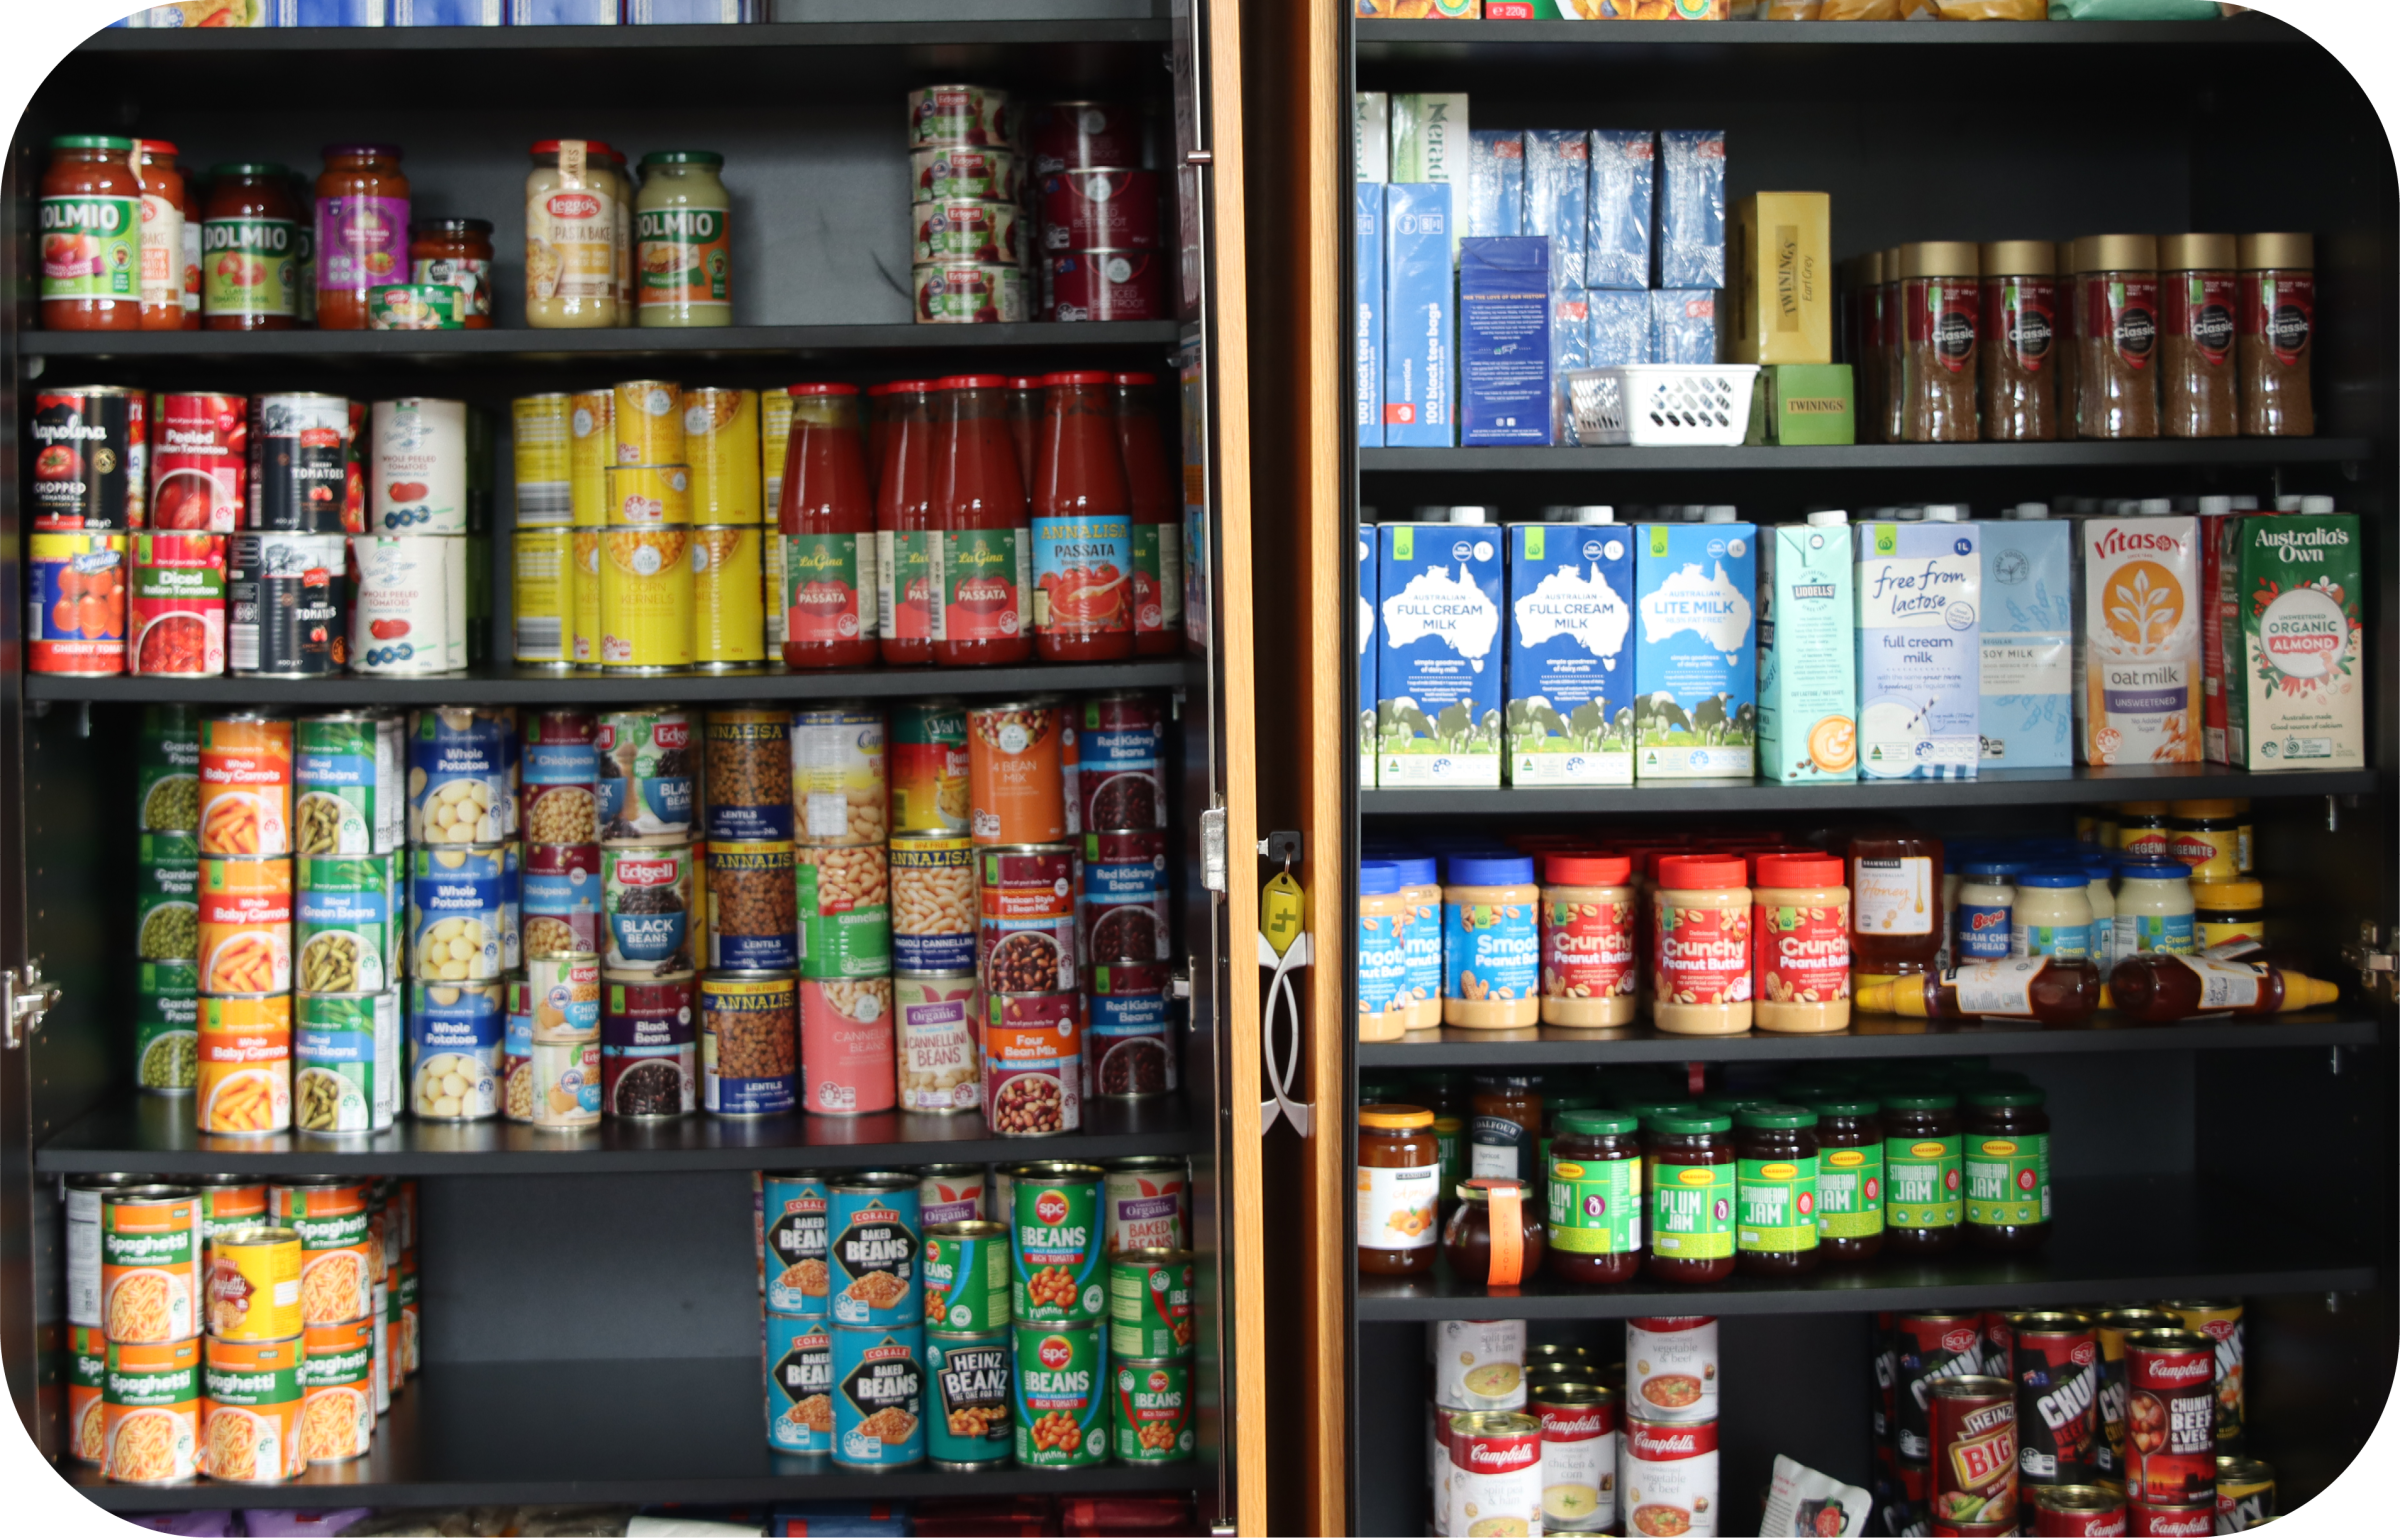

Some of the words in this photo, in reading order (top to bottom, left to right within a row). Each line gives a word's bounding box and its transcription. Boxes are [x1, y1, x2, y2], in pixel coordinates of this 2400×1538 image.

[1506, 6, 1526, 18] 220g
[952, 155, 983, 167] Edgell
[551, 198, 597, 215] Leggo's
[204, 226, 287, 250] DOLMIO
[555, 227, 587, 240] PASTA
[589, 226, 611, 240] BAKE
[1801, 255, 1814, 278] Grey
[1778, 238, 1797, 317] TWININGS
[1801, 278, 1812, 302] Earl
[1426, 303, 1442, 337] bags
[1931, 327, 1975, 342] Classic
[2009, 326, 2052, 341] Classic
[2114, 325, 2155, 339] Classic
[1426, 338, 1438, 359] tea
[1426, 360, 1438, 402] black
[1789, 401, 1844, 411] TWININGS
[1426, 403, 1438, 425] 100
[167, 429, 214, 444] Peeled
[383, 455, 407, 463] WHOLE
[408, 455, 436, 463] PEELED
[292, 468, 344, 480] TOMATOES
[1041, 524, 1127, 540] ANNALISA
[2255, 527, 2349, 548] Australia's
[2094, 527, 2187, 560] Vitasoy
[1054, 543, 1115, 558] PASSATA
[2278, 546, 2325, 563] Own
[159, 572, 203, 584] Diced
[1873, 565, 1915, 599] free
[1918, 561, 1966, 591] from
[629, 583, 666, 592] CORN
[621, 594, 674, 605] KERNELS
[799, 593, 846, 603] PASSATA
[958, 589, 1007, 600] PASSATA
[1397, 605, 1430, 615] FULL
[1433, 605, 1483, 615] CREAM
[1529, 604, 1562, 614] FULL
[1564, 604, 1614, 614] CREAM
[1654, 601, 1689, 614] LITE
[1693, 601, 1734, 614] MILK
[1891, 593, 1946, 615] lactose
[1423, 620, 1456, 629] MILK
[1554, 618, 1588, 629] MILK
[2268, 620, 2337, 634] ORGANIC
[1883, 635, 1905, 648] full
[1908, 637, 1953, 648] cream
[2273, 637, 2334, 650] ALMOND
[1903, 652, 1932, 663] milk
[1983, 650, 2003, 658] SOY
[2111, 671, 2138, 686] oat
[2142, 667, 2179, 684] milk
[2115, 697, 2176, 708] UNSWEETENED
[2281, 713, 2313, 721] Australian
[2314, 713, 2332, 721] made
[1097, 736, 1119, 747] Red
[1121, 735, 1154, 749] Kidney
[1111, 747, 1145, 758] Beans
[226, 759, 255, 769] Whole
[438, 760, 489, 771] Potatoes
[539, 755, 594, 768] Chickpeas
[992, 762, 1000, 772] 4
[1002, 761, 1037, 771] BEAN
[206, 769, 233, 782] Baby
[235, 769, 280, 780] Carrots
[1003, 773, 1027, 782] MIX
[721, 811, 757, 819] LENTILS
[2171, 845, 2213, 857] EGEMITE
[620, 863, 673, 883] Edgell
[1097, 869, 1118, 879] Red
[1119, 868, 1155, 883] Kidney
[162, 881, 193, 893] Peas
[1109, 880, 1145, 890] Beans
[1859, 878, 1911, 910] Honey
[241, 898, 269, 908] Whole
[431, 897, 484, 908] Potatoes
[215, 908, 247, 922] Baby
[249, 908, 290, 918] Carrots
[304, 907, 335, 917] Green
[337, 907, 375, 917] Beans
[621, 919, 673, 933] BLACK
[1972, 910, 2005, 930] Bega
[627, 933, 668, 943] BEANS
[744, 940, 781, 949] LENTILS
[2165, 935, 2191, 944] Cream
[1664, 936, 1745, 959] Crunchy
[1972, 943, 2005, 951] SPREAD
[1663, 956, 1706, 970] Peanut
[1708, 956, 1745, 969] Butter
[912, 1008, 956, 1023] Organic
[636, 1021, 669, 1032] Black
[426, 1034, 478, 1045] Potatoes
[634, 1033, 671, 1044] Beans
[1016, 1035, 1044, 1045] Four
[917, 1048, 961, 1067] BEANS
[1005, 1047, 1034, 1057] Bean
[1036, 1046, 1057, 1056] Mix
[745, 1082, 782, 1090] LENTILS
[1890, 1164, 1938, 1181] STRAWBERRY
[1740, 1186, 1789, 1203] STRAWBERRY
[1895, 1181, 1932, 1201] JAM
[1968, 1179, 2001, 1199] JAM
[1661, 1189, 1701, 1214] PLUM
[855, 1212, 894, 1221] CORALE
[1039, 1203, 1065, 1218] spc
[1745, 1203, 1782, 1225] JAM
[294, 1212, 368, 1237] Spaghetti
[794, 1218, 824, 1229] BAKED
[1665, 1214, 1693, 1231] JAM
[106, 1229, 188, 1253] Spaghetti
[860, 1229, 891, 1240] BAKED
[846, 1239, 909, 1262] BEANS
[1048, 1254, 1075, 1262] TOMATO
[1945, 1335, 1973, 1348] SOUP
[869, 1349, 907, 1359] CORALE
[1043, 1349, 1068, 1362] spc
[1652, 1342, 1697, 1356] vegetable
[954, 1352, 1002, 1372] HEINZ
[1659, 1354, 1667, 1363] &
[1670, 1353, 1692, 1363] beef
[873, 1365, 904, 1376] BAKED
[109, 1370, 191, 1395] Spaghetti
[946, 1370, 1008, 1394] BEANZ
[1052, 1399, 1078, 1407] TOMATO
[2171, 1394, 2212, 1412] CHUNKY
[1541, 1413, 1601, 1435] Campbell's
[2171, 1410, 2212, 1429] BEEF
[2171, 1434, 2178, 1444] &
[2179, 1429, 2208, 1443] VEG
[1470, 1443, 1533, 1464] Campbell's
[1961, 1434, 2011, 1482] BIG
[1642, 1473, 1686, 1485] vegetable
